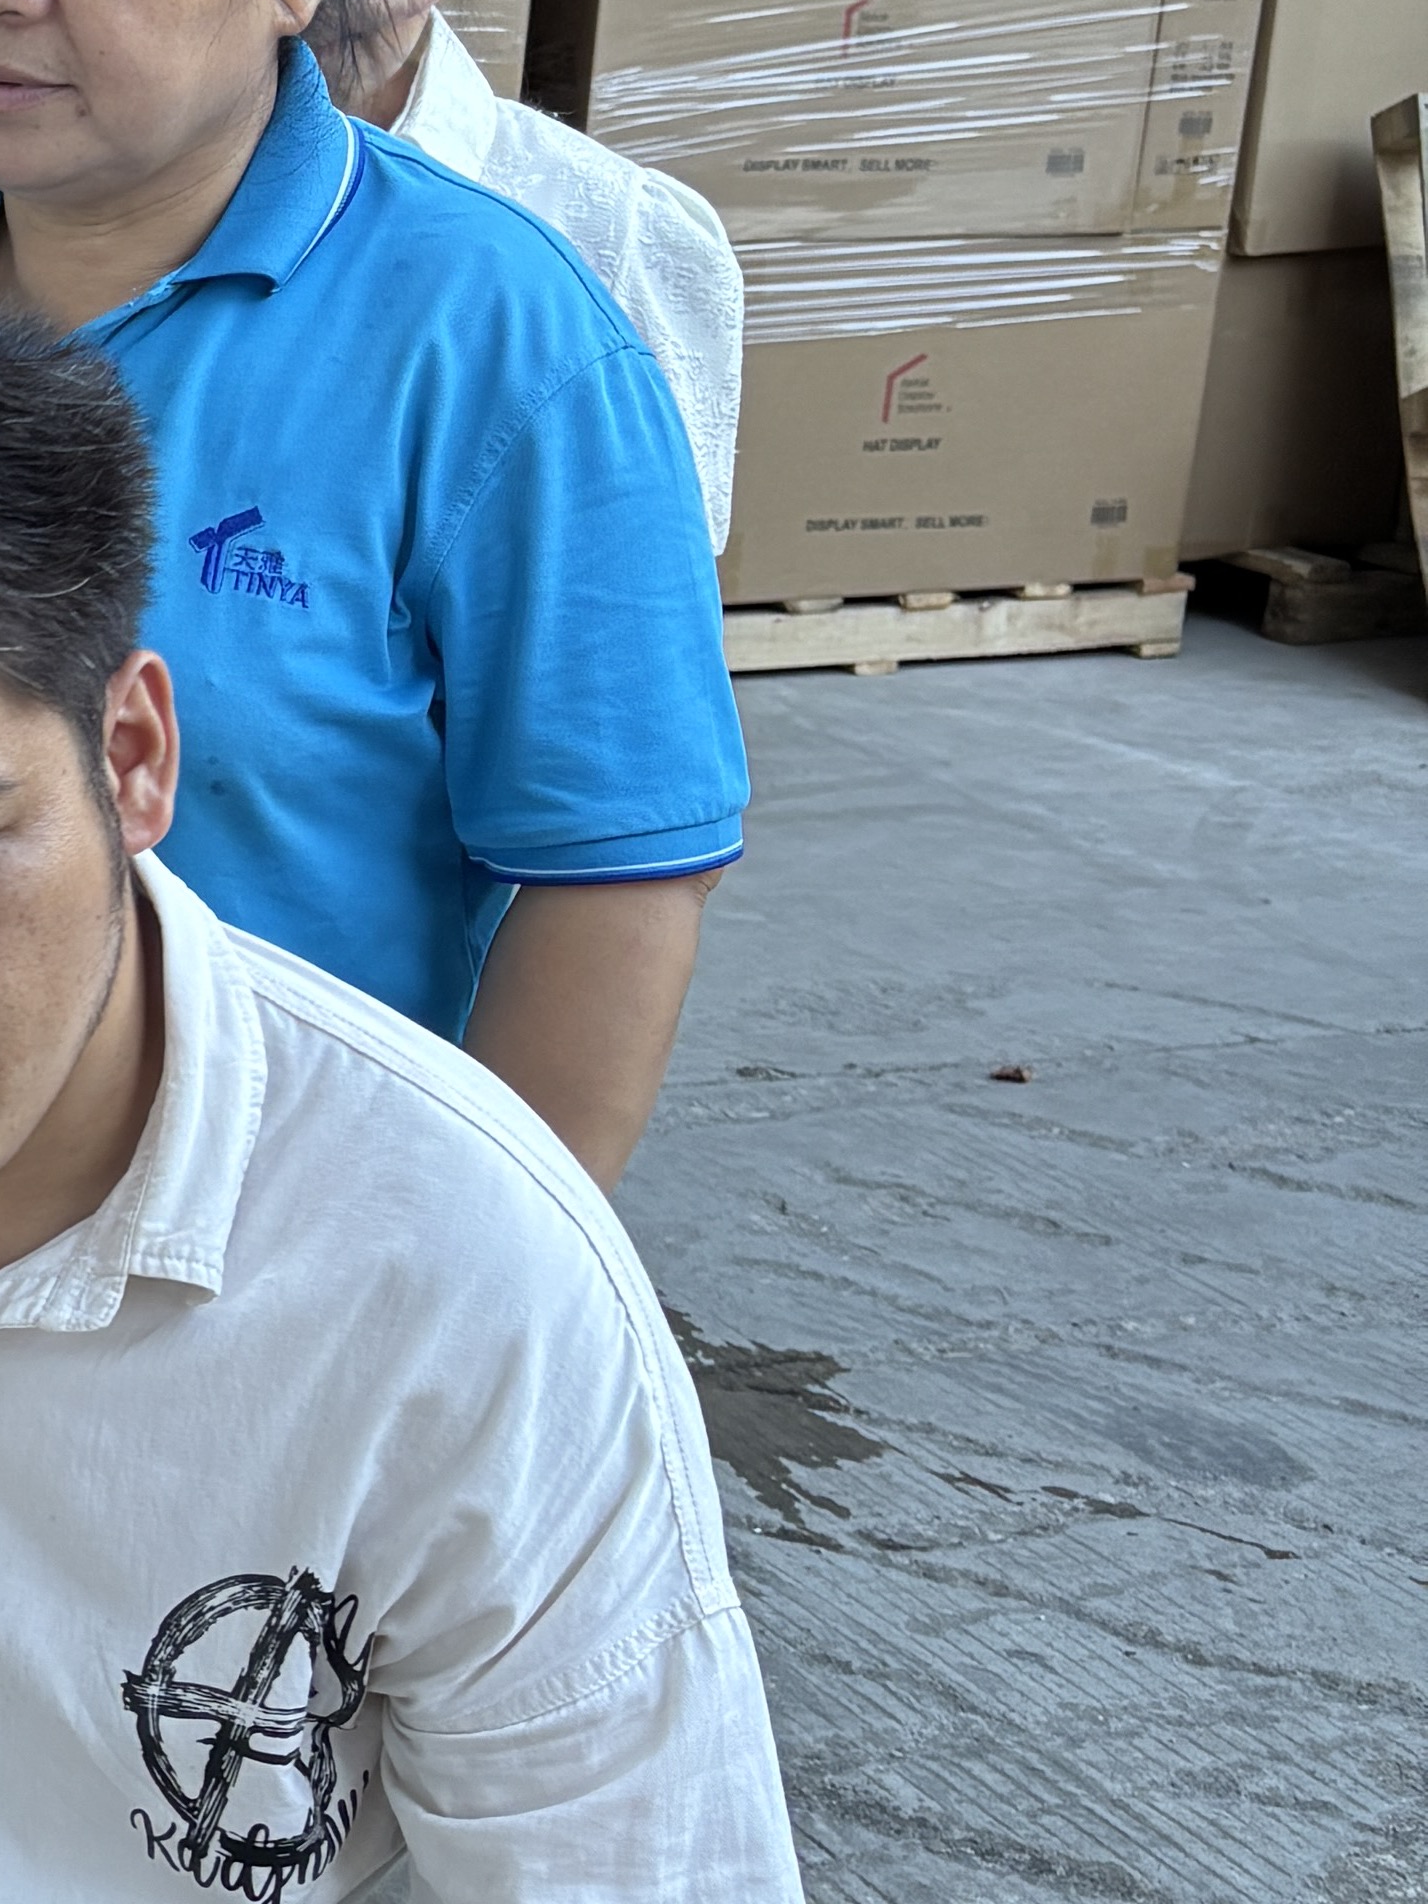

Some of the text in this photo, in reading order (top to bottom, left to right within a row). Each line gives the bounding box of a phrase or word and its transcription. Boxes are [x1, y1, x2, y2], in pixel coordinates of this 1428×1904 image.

[743, 159, 799, 172] DISPLAY
[859, 158, 891, 172] SELL
[863, 437, 942, 452] HAT DISPLAY
[806, 519, 857, 532] DISPLAY
[915, 516, 946, 530] SELL
[230, 569, 310, 609] TINYA
